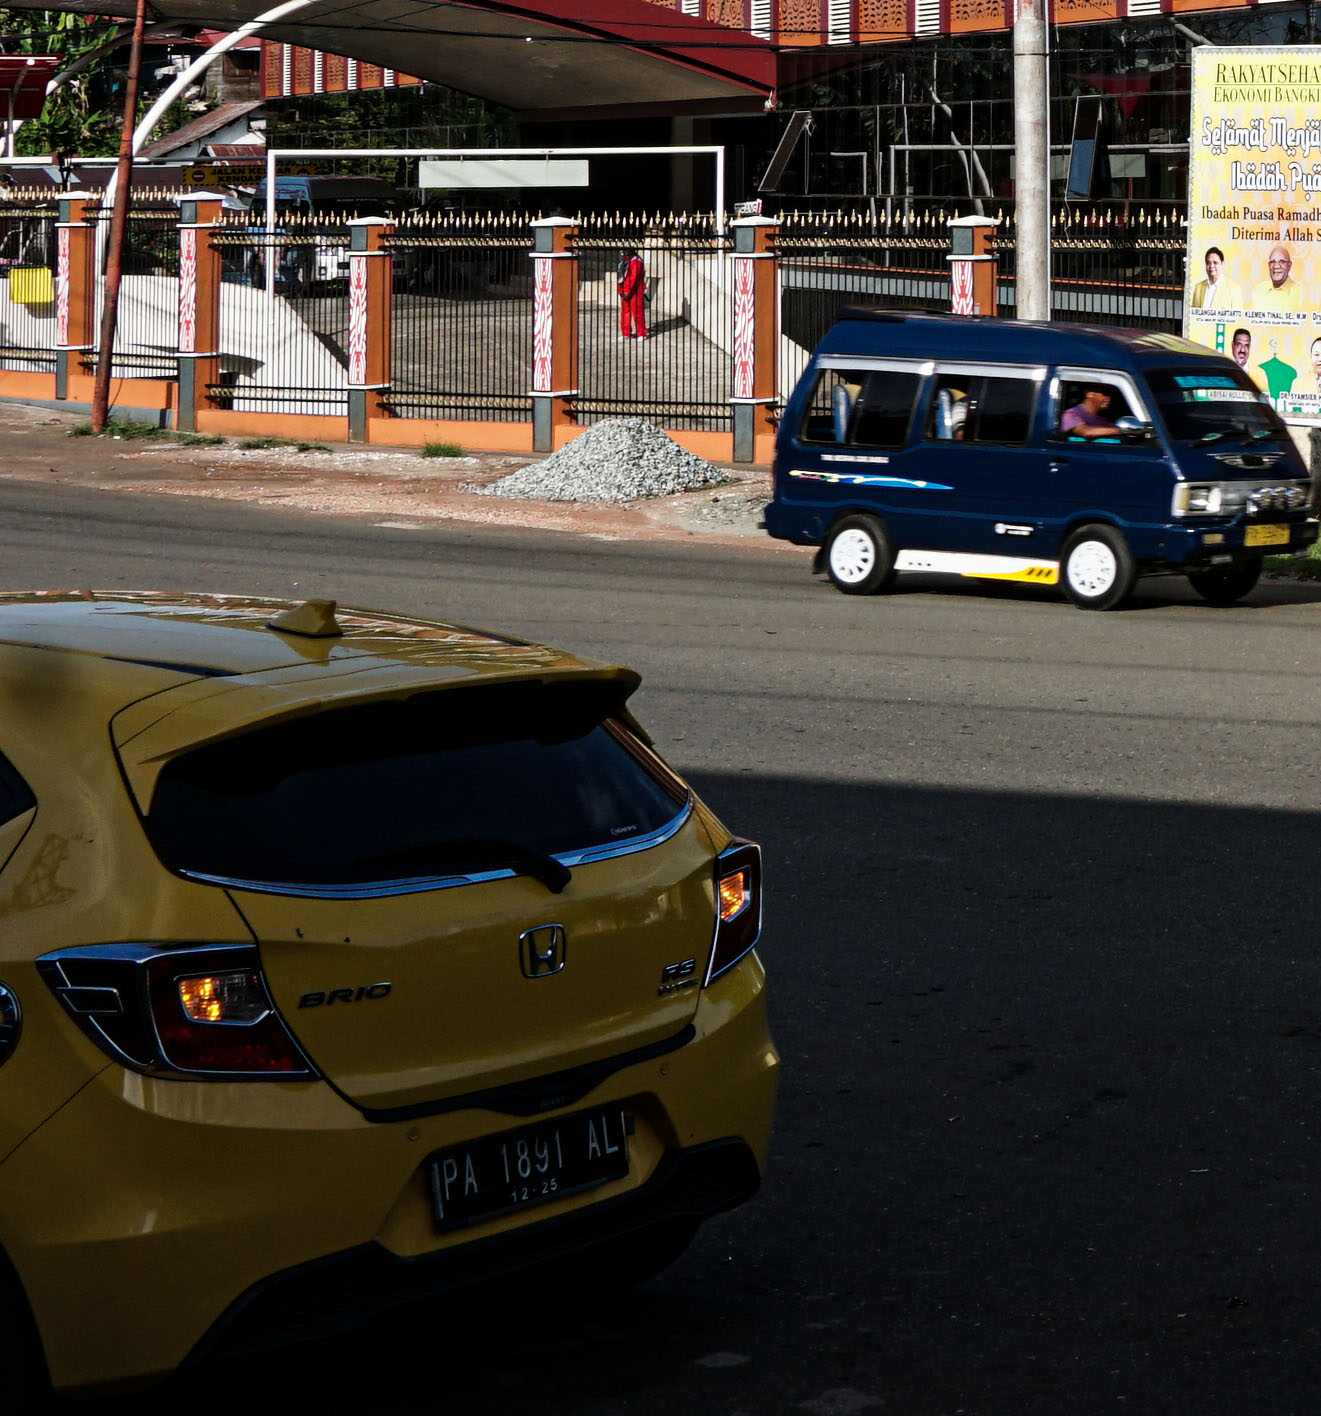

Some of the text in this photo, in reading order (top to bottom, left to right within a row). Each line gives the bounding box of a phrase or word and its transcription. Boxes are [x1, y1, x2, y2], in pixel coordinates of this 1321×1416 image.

[1216, 63, 1277, 83] RAKYAT
[1214, 86, 1271, 103] EKONOMI
[1202, 117, 1267, 155] Selamat
[210, 167, 246, 175] JALAN
[1231, 161, 1288, 191] Ibadah
[1202, 206, 1240, 220] Ibadah
[1243, 207, 1274, 221] Puasa
[1232, 227, 1280, 241] Diterima
[1284, 228, 1314, 242] Allah
[1245, 311, 1266, 319] KLEMEN
[1291, 392, 1317, 401] SYAMSIER
[662, 958, 696, 983] RS
[298, 981, 392, 1009] BRIO
[443, 1115, 619, 1201] PA 1891 AL
